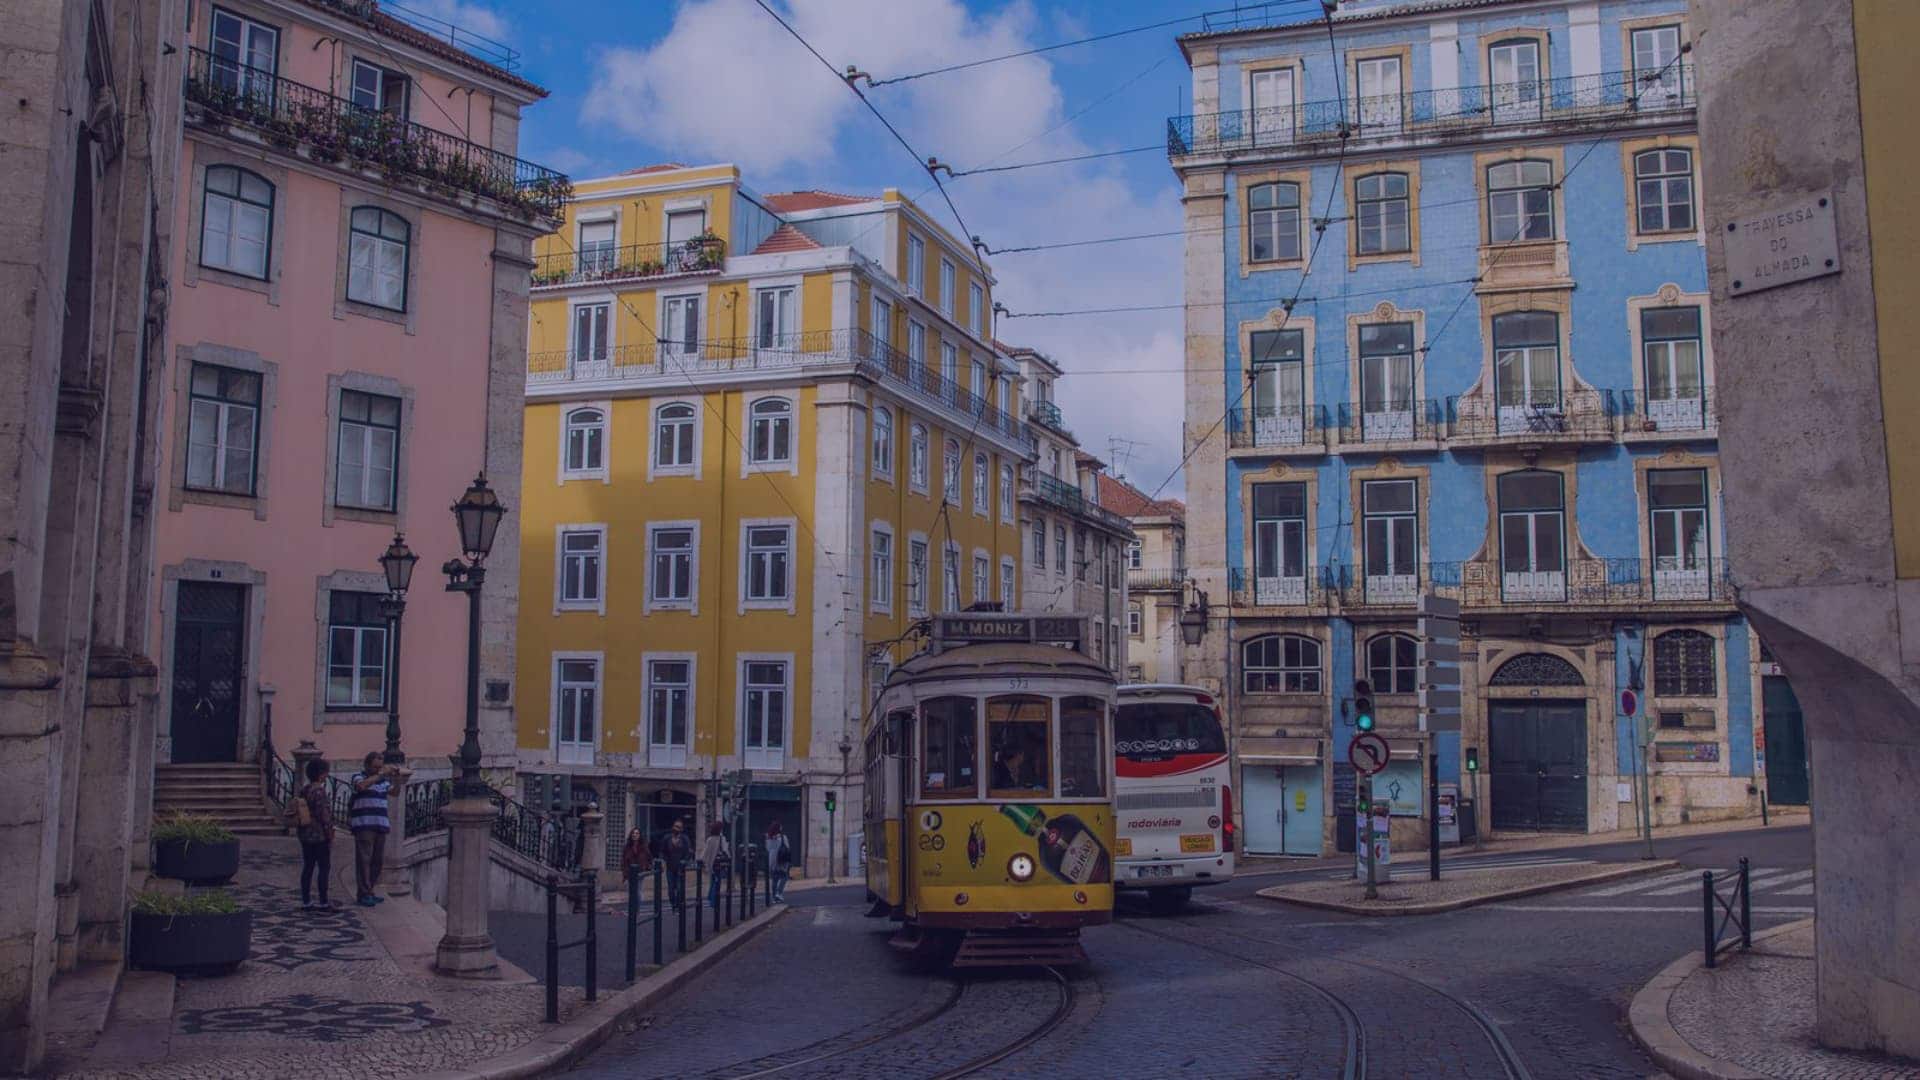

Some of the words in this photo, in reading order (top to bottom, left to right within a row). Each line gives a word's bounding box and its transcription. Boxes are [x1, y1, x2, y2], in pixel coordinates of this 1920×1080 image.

[1744, 207, 1814, 236] TRAVESSA
[1770, 237, 1787, 252] DO
[1755, 255, 1810, 278] ALMADA
[1043, 621, 1069, 635] 28
[1009, 679, 1030, 689] 573
